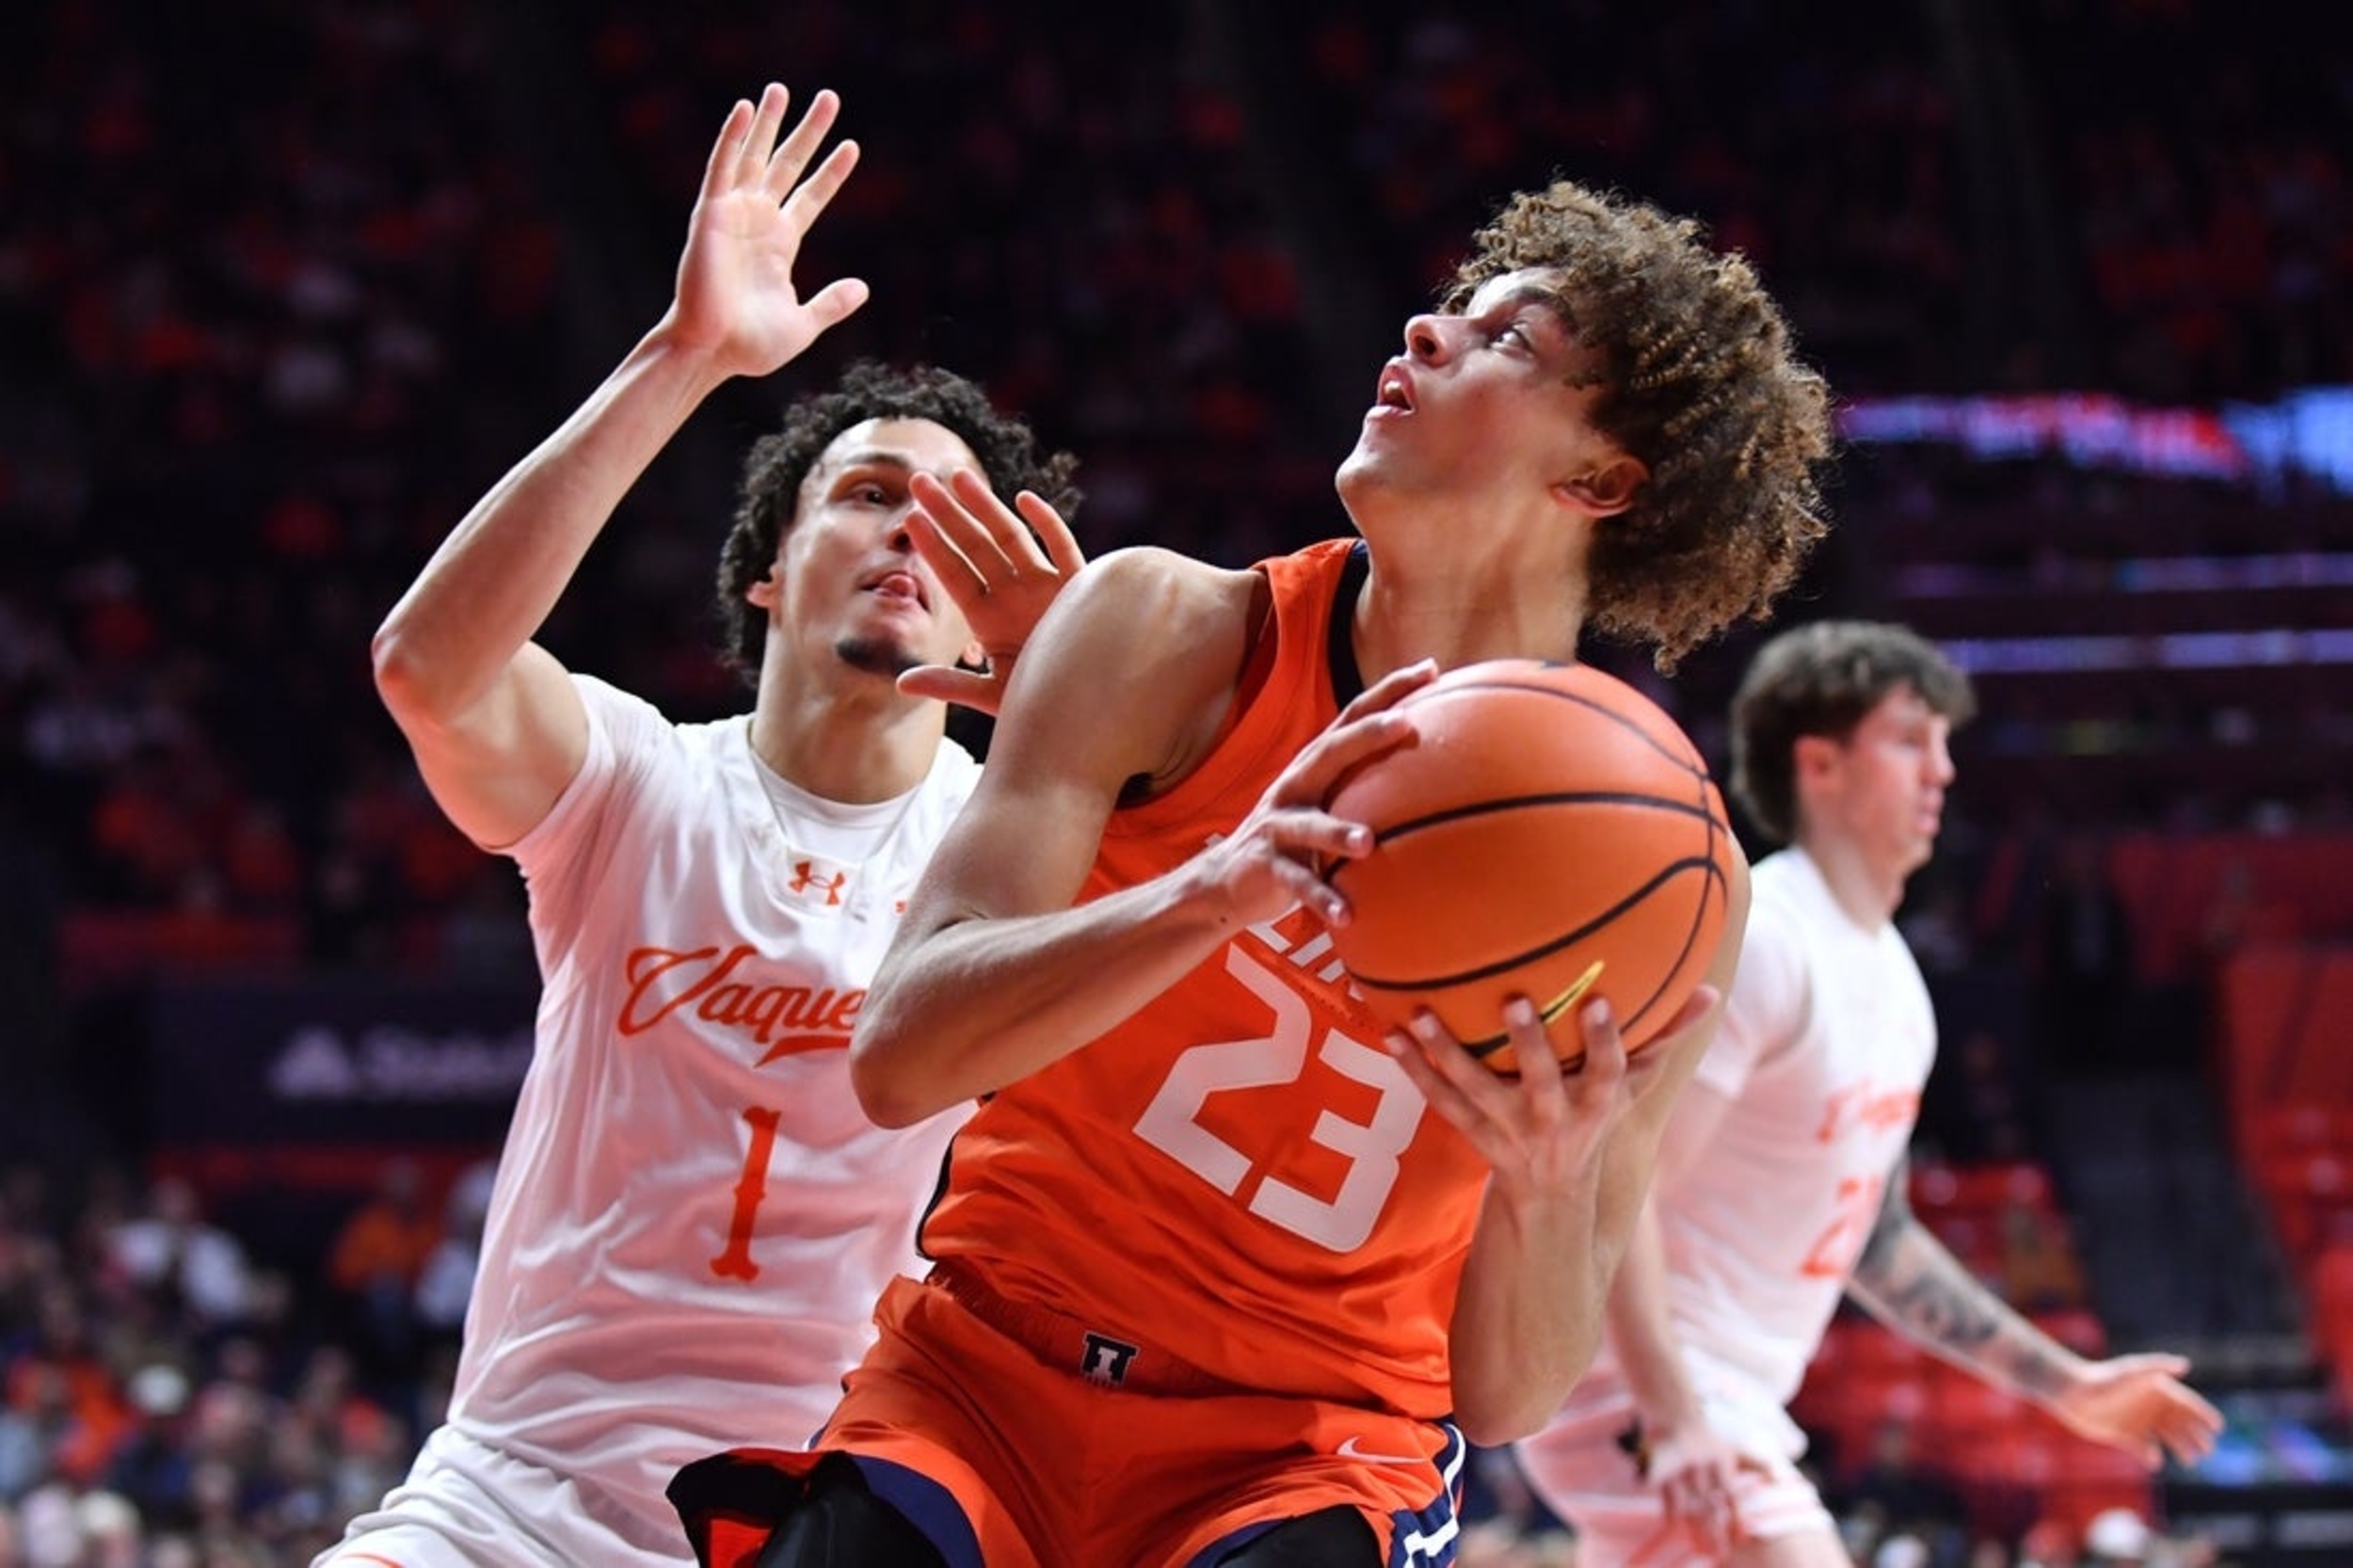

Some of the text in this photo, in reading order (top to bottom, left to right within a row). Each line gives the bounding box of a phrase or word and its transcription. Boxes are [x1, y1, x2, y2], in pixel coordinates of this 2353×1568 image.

[618, 945, 868, 1046] Vaque
[1132, 941, 1427, 1253] 23
[711, 1105, 781, 1282] 1
